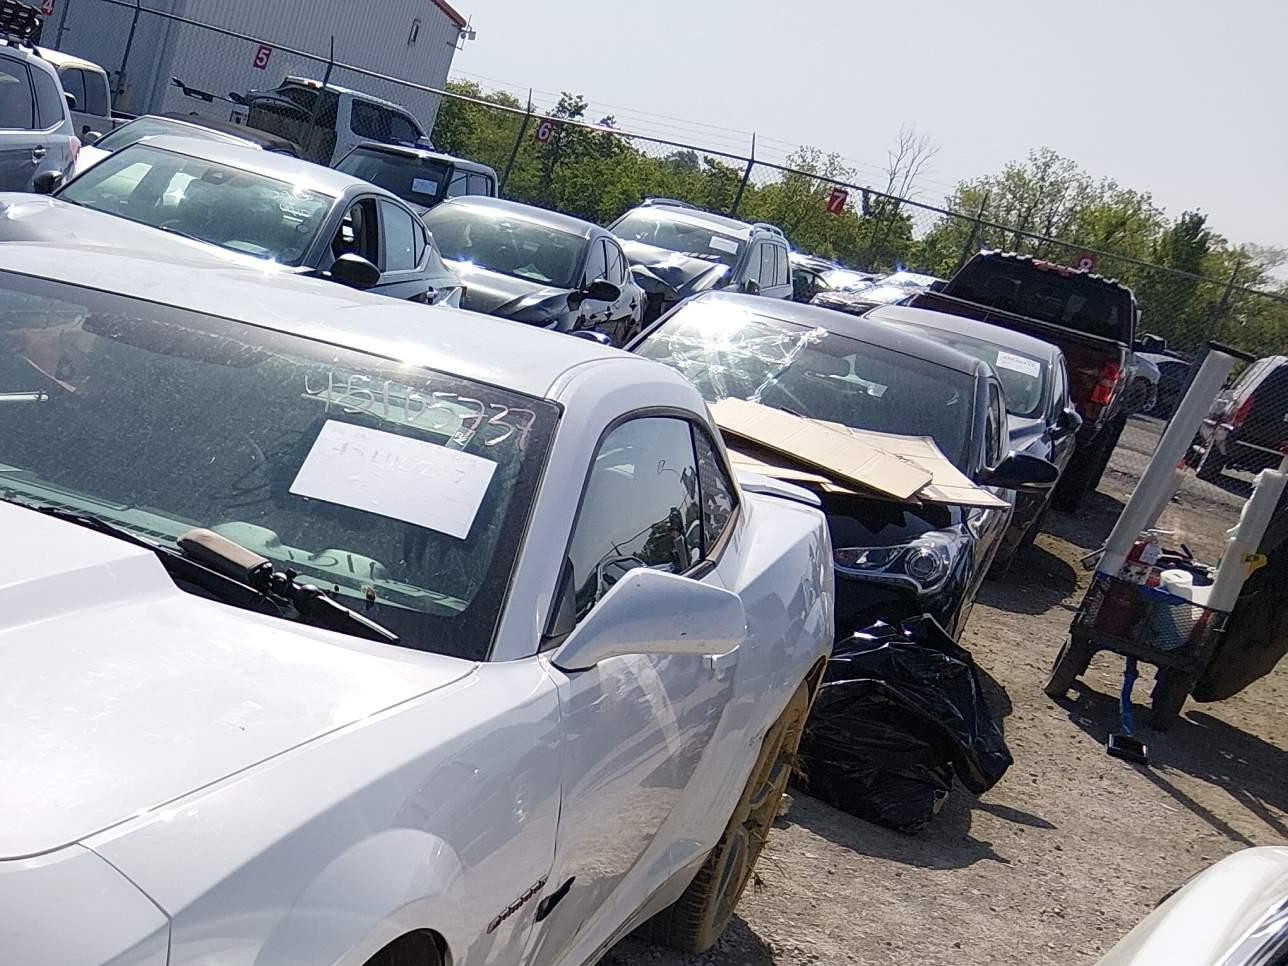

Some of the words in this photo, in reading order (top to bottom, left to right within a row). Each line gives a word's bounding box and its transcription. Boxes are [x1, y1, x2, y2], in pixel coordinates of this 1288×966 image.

[42, 0, 53, 13] 4
[256, 49, 270, 66] 5
[538, 122, 552, 140] 6
[831, 191, 846, 210] 7
